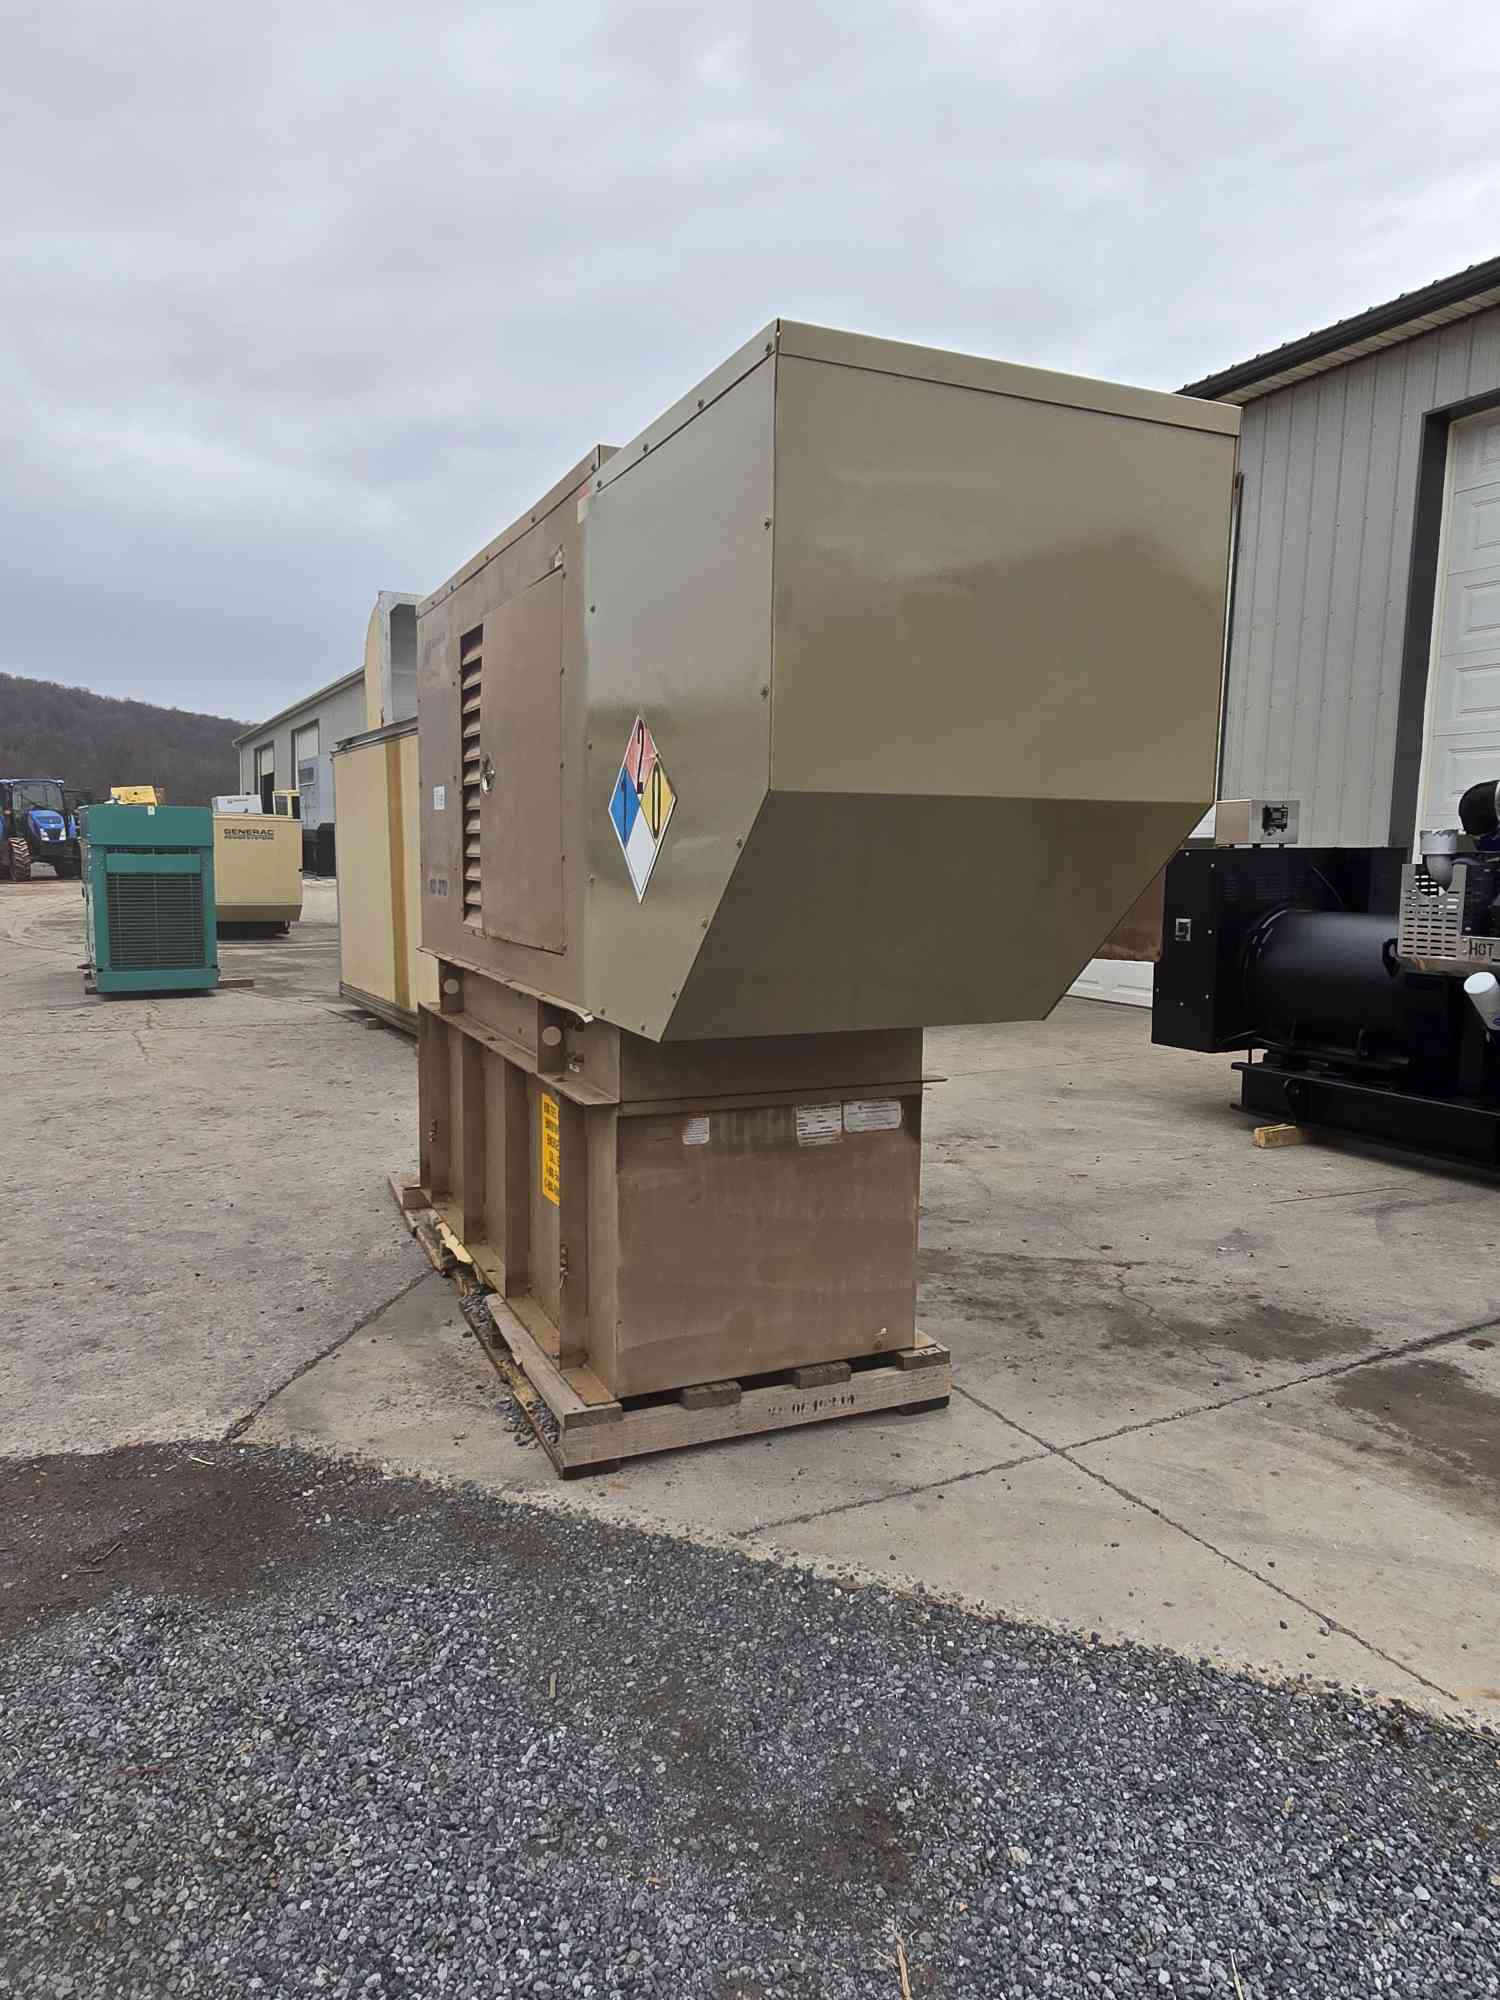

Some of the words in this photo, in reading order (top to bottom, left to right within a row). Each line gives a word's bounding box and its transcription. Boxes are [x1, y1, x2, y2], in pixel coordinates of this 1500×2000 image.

[637, 719, 645, 794] 2
[223, 828, 274, 836] GENERAC
[620, 772, 627, 846] 1
[651, 760, 662, 840] 0
[1469, 940, 1494, 957] HOT
